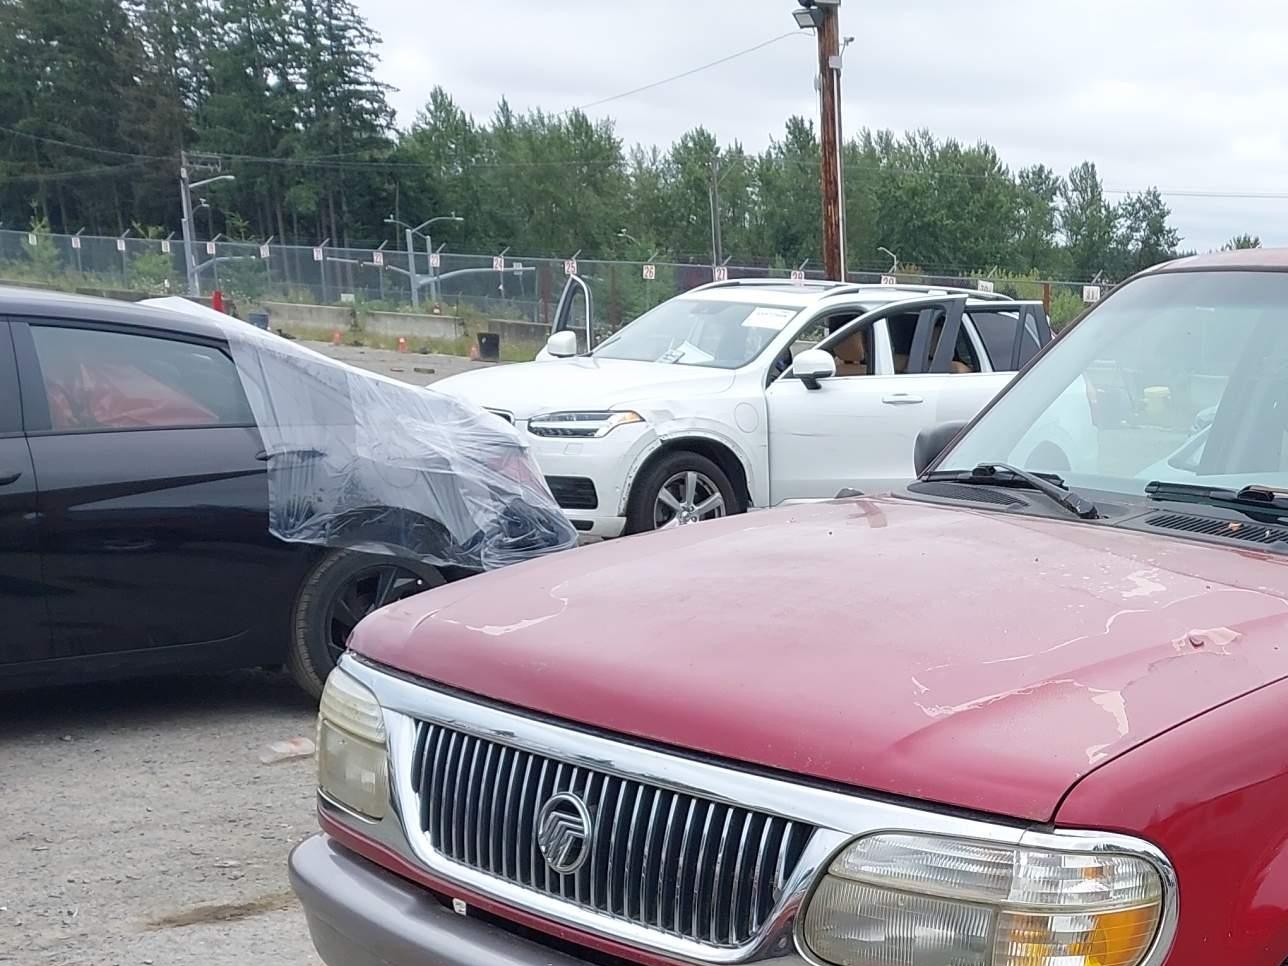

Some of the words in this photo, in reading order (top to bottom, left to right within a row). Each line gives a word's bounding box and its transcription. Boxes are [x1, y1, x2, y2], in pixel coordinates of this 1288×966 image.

[566, 261, 576, 274] 25
[644, 266, 655, 279] 26
[716, 267, 726, 280] 27
